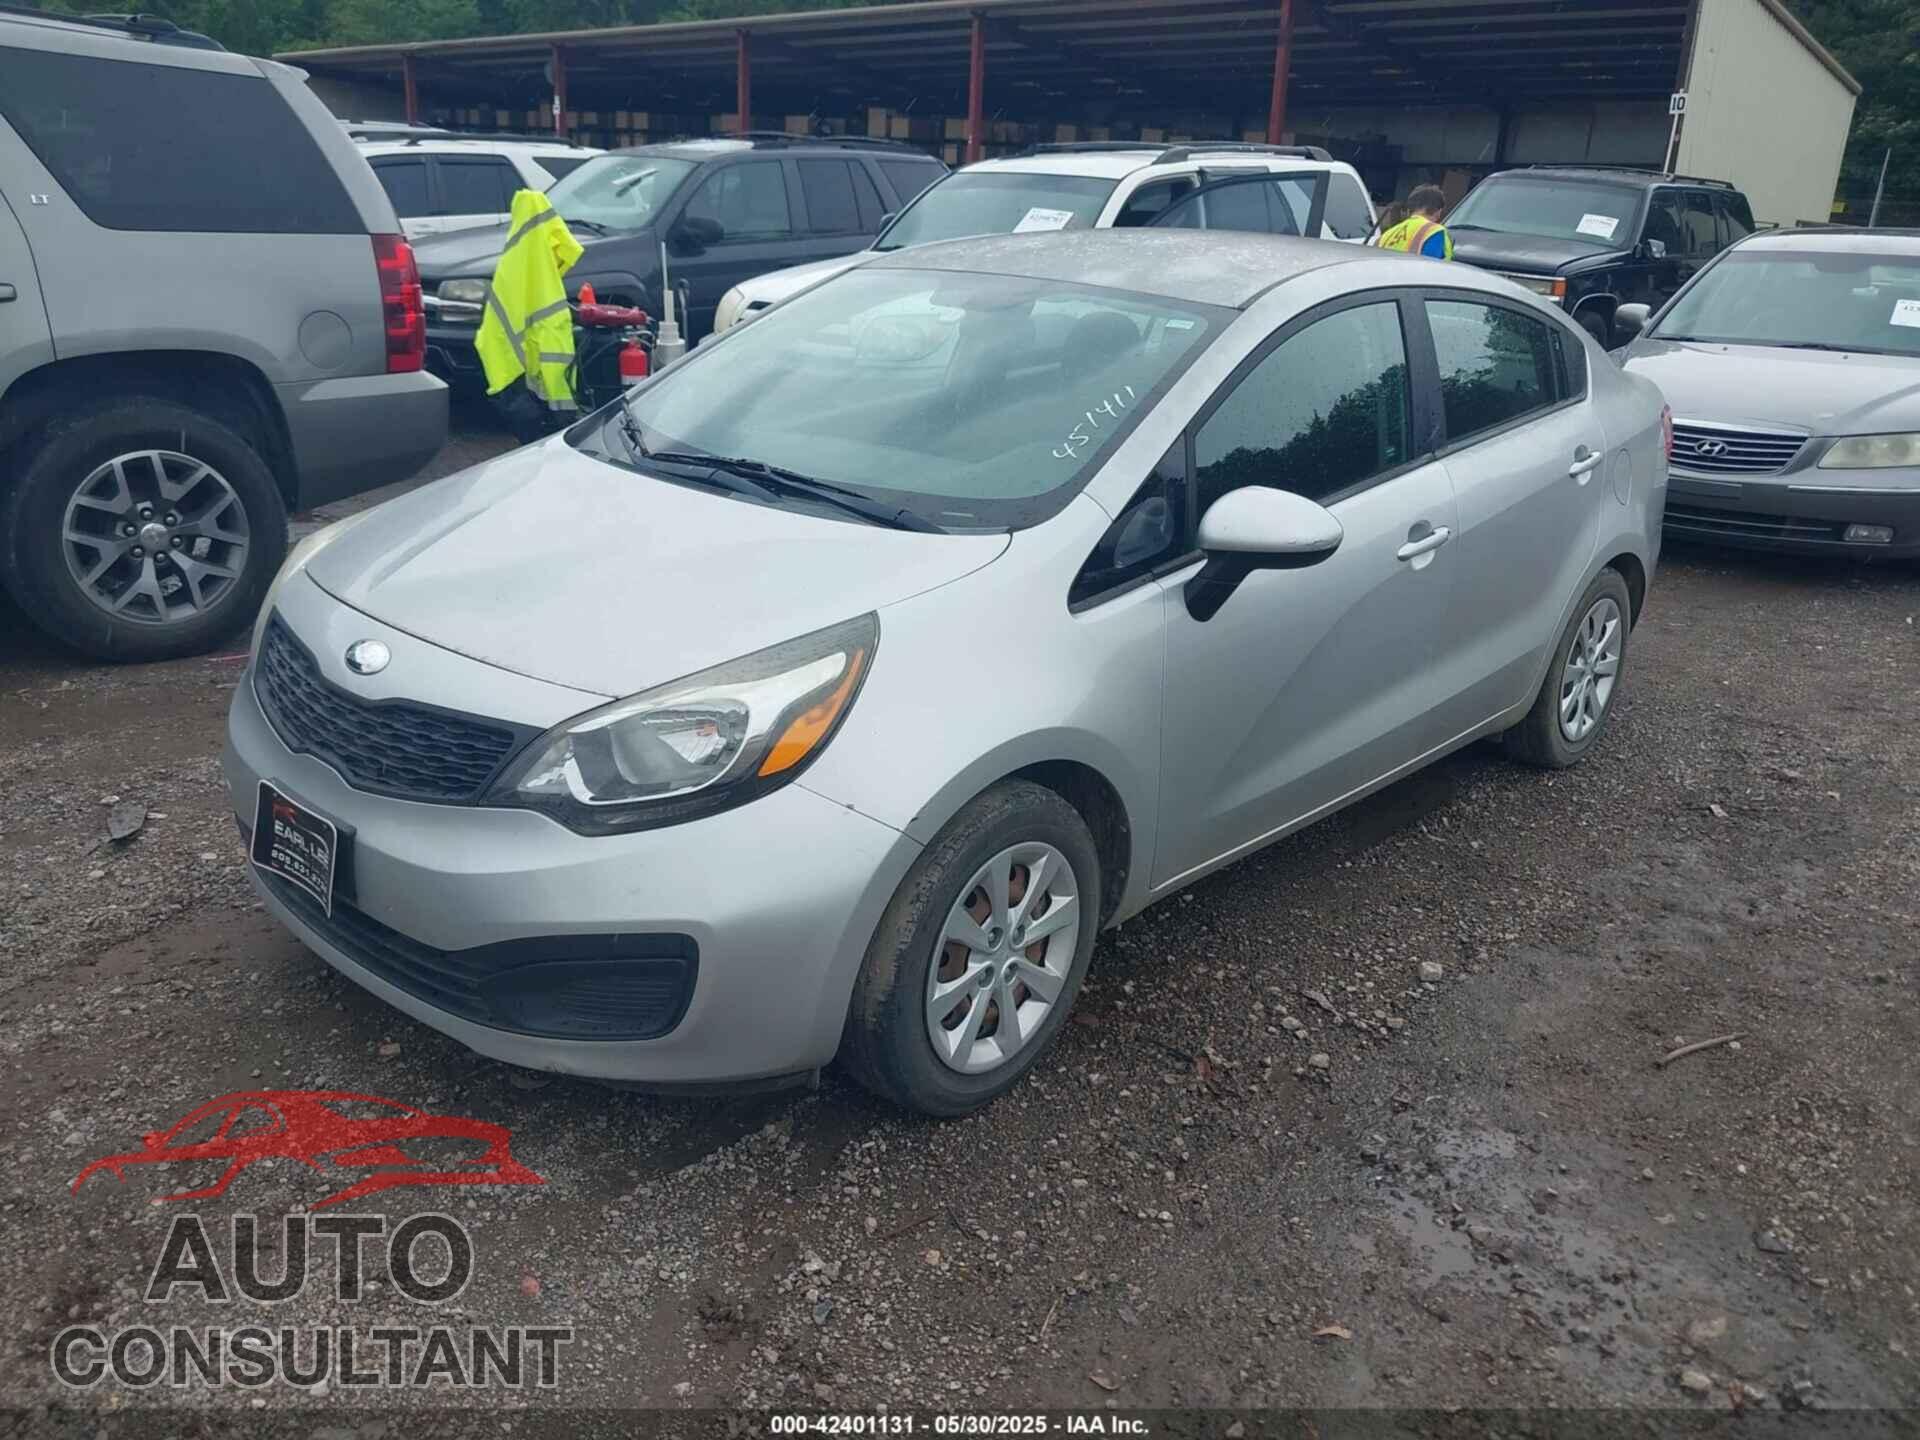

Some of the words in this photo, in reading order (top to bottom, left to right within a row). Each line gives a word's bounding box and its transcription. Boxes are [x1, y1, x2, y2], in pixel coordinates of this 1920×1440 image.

[1671, 96, 1686, 111] 10
[31, 194, 48, 204] LT
[274, 819, 310, 854] EARL
